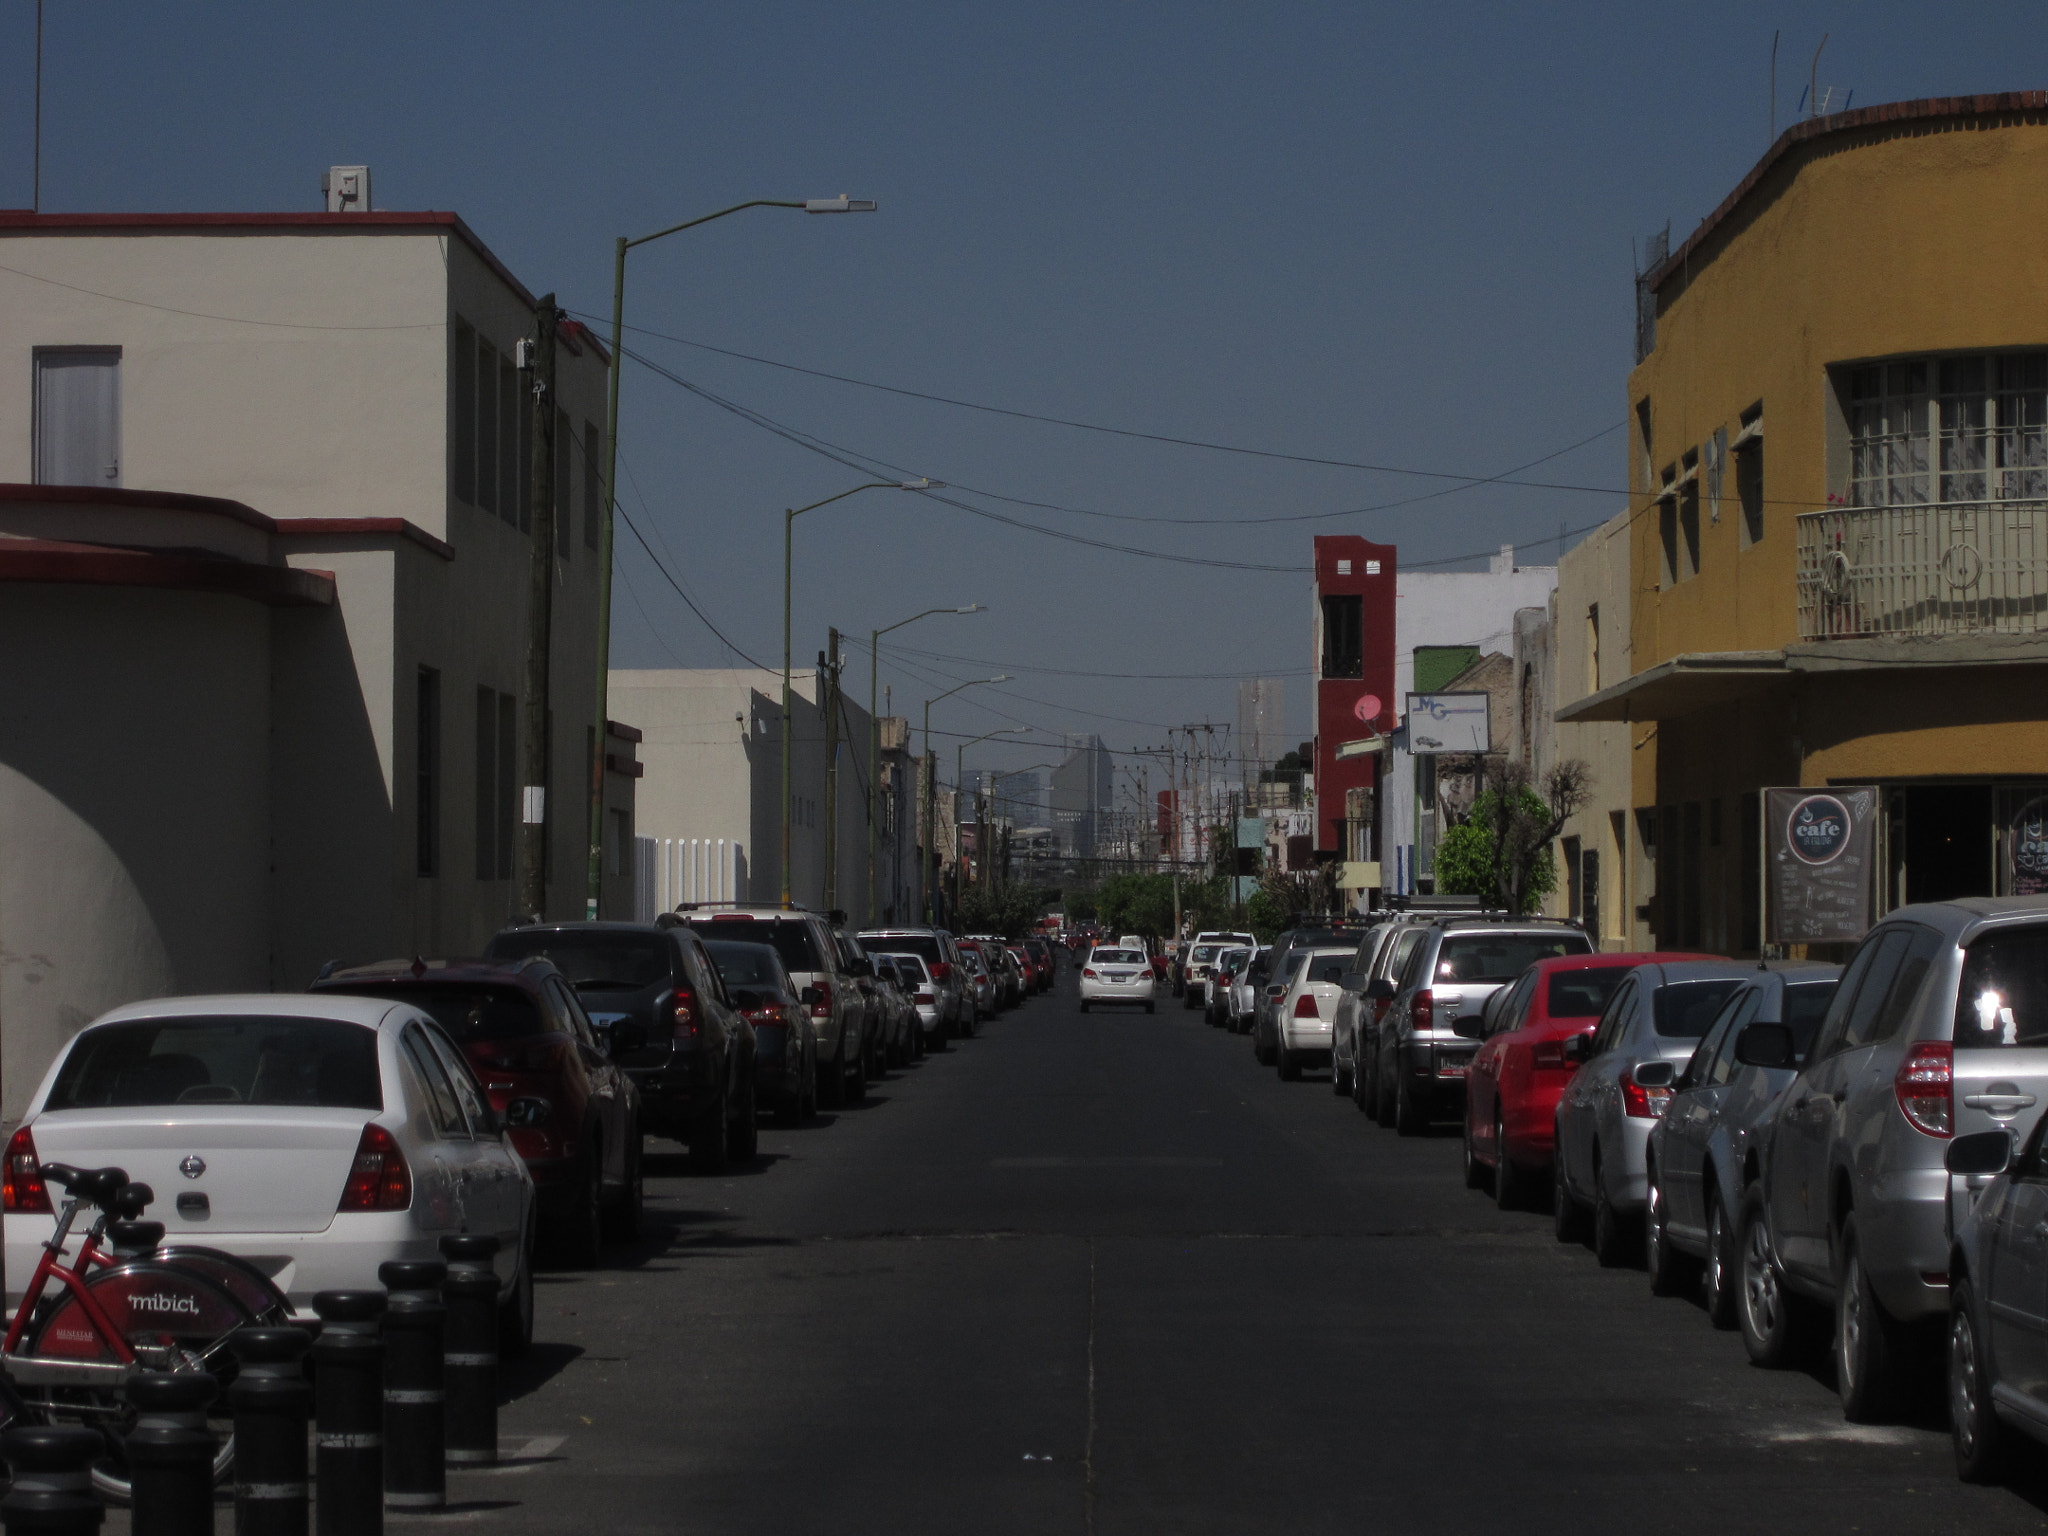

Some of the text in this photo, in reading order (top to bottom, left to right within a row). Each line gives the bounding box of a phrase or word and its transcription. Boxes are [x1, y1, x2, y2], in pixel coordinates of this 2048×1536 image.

[1418, 696, 1447, 720] MG
[1796, 820, 1841, 837] cafe
[129, 1292, 198, 1314] mibici
